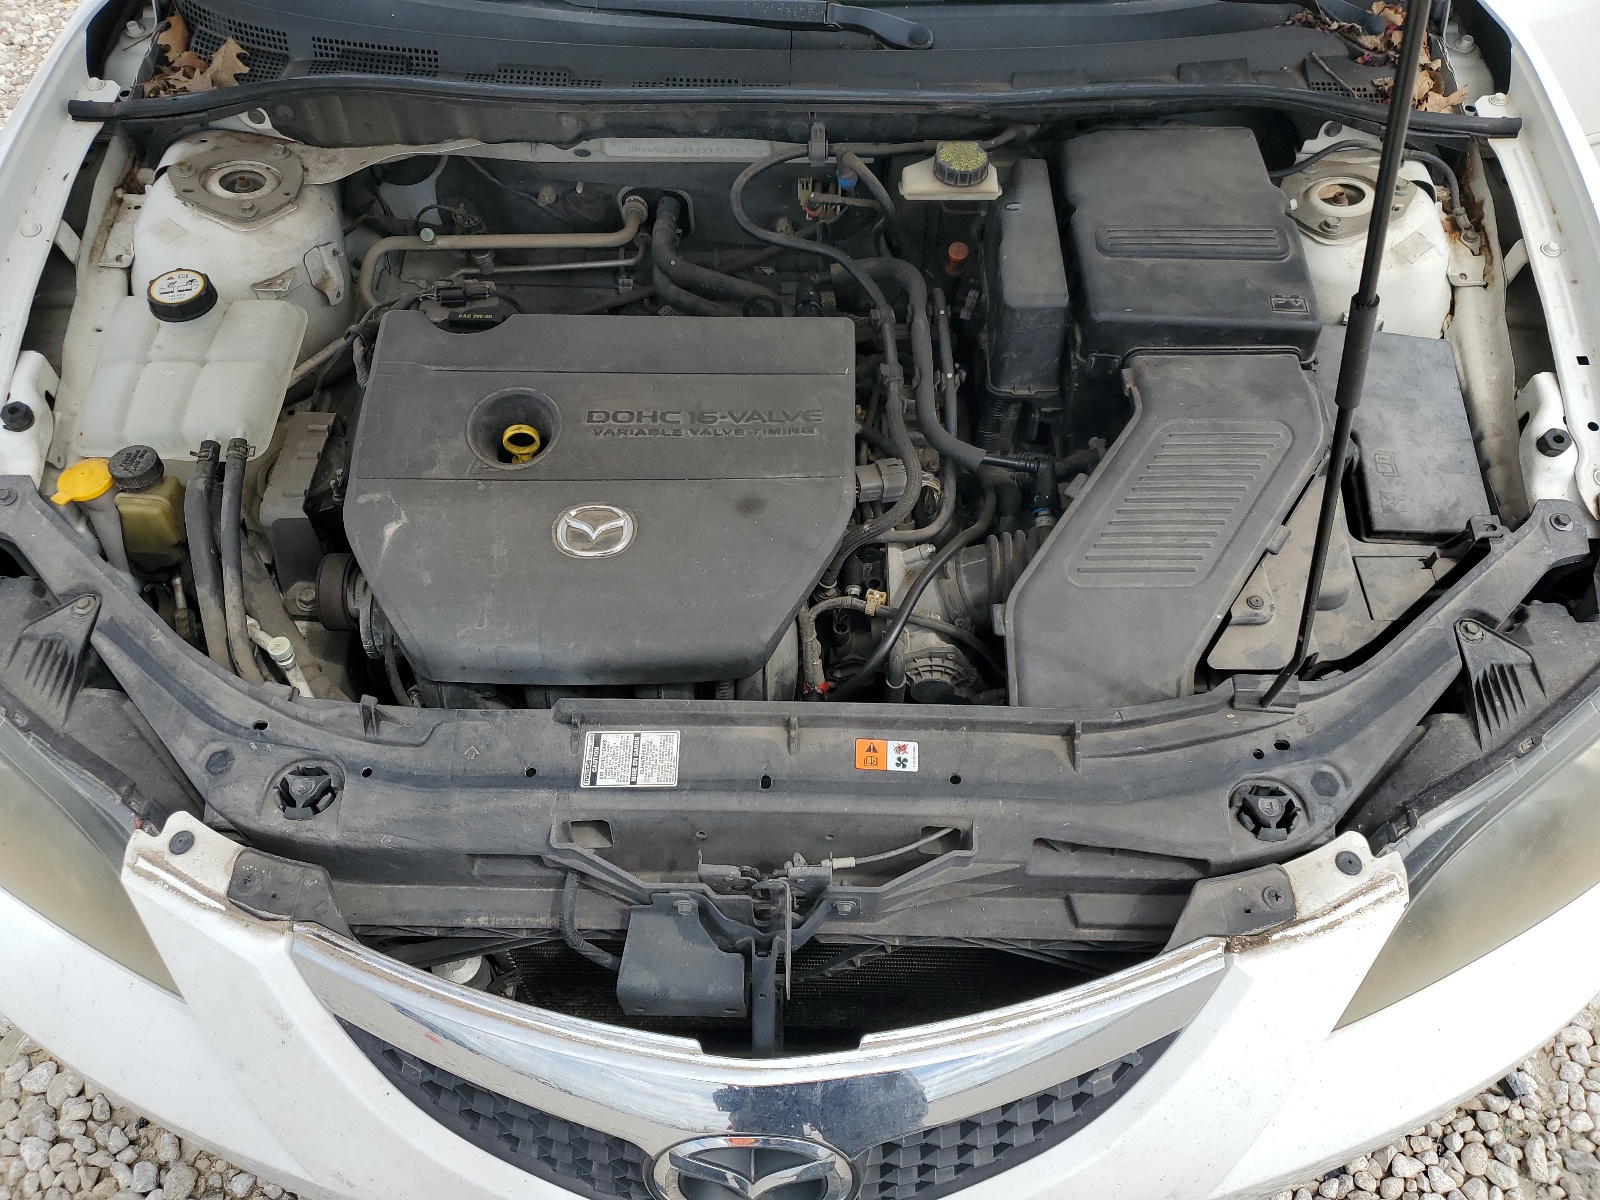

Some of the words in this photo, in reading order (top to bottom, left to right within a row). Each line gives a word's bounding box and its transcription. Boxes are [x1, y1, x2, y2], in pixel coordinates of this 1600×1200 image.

[586, 410, 682, 424] DOHC
[688, 409, 823, 424] 16-VALVE
[592, 428, 684, 437] VARIABLE
[688, 428, 746, 437] VALVE
[751, 427, 815, 437] TIMING
[591, 746, 600, 773] CAUTION
[632, 757, 639, 766] EN
[630, 766, 638, 782] MISE
